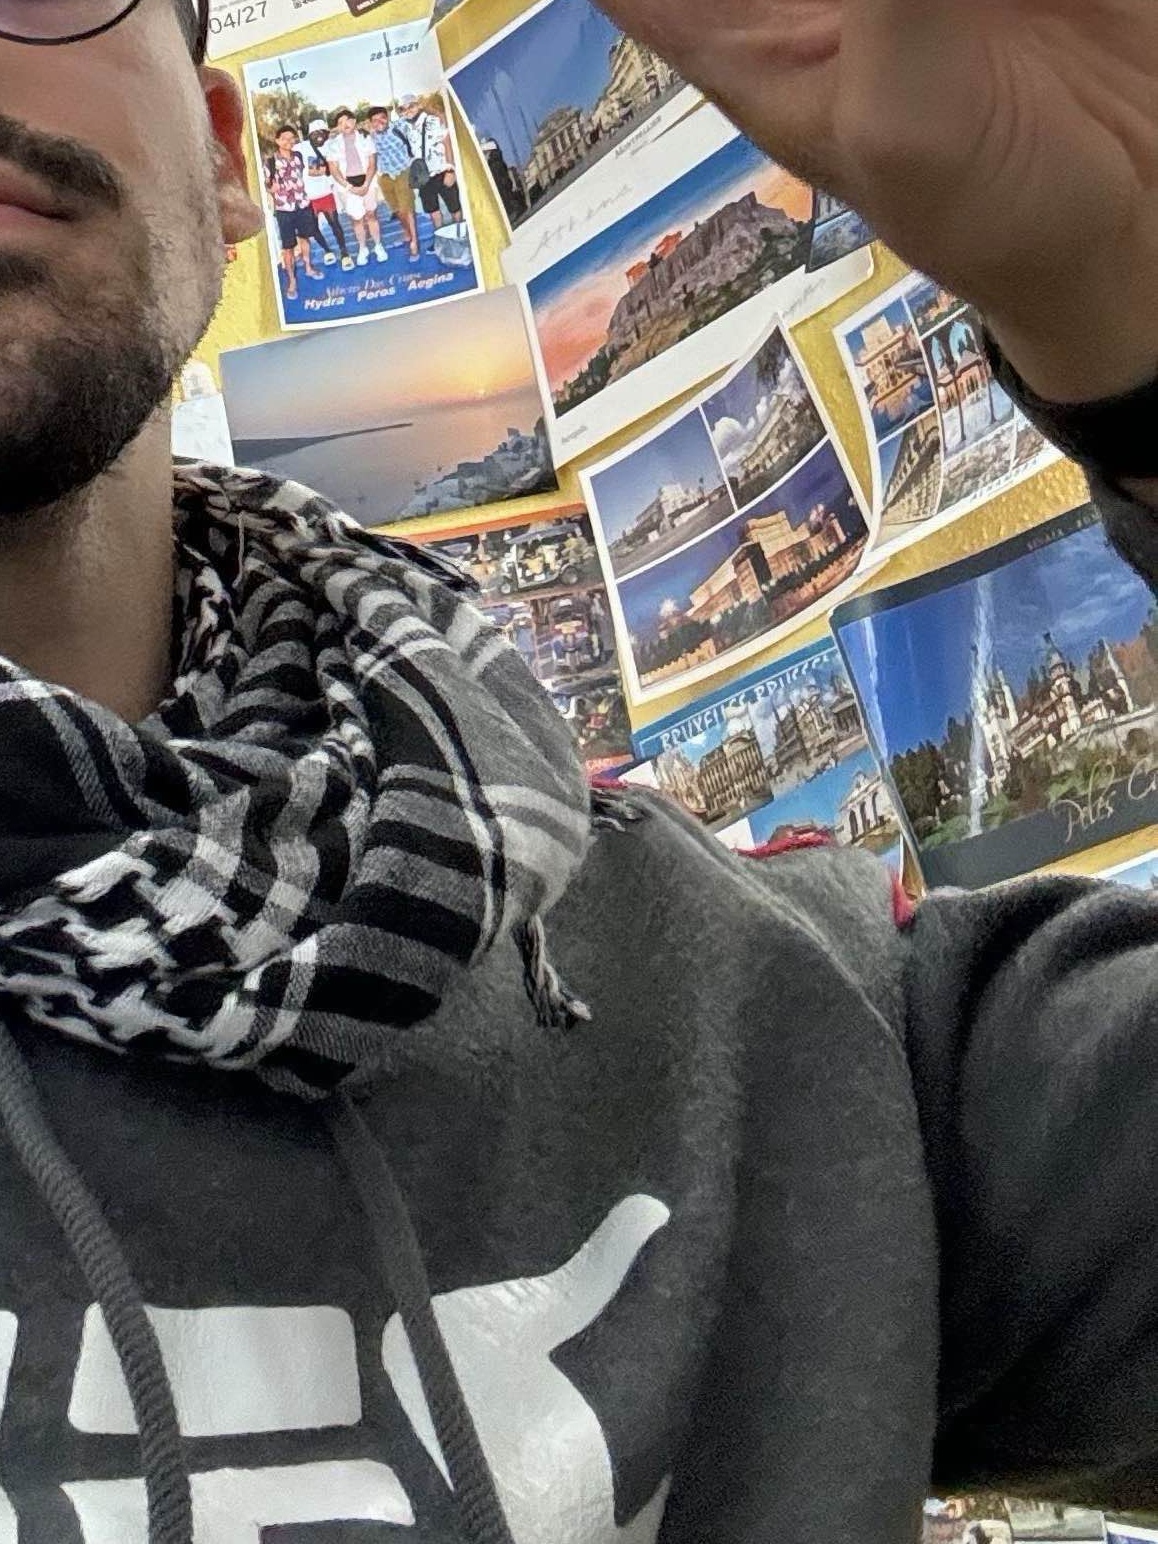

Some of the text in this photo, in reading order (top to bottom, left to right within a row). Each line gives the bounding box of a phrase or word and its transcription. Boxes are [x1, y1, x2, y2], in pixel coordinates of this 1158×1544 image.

[209, 0, 268, 35] 04/27
[259, 69, 308, 89] Greece
[304, 270, 455, 311] Hydra Poros Aegina
